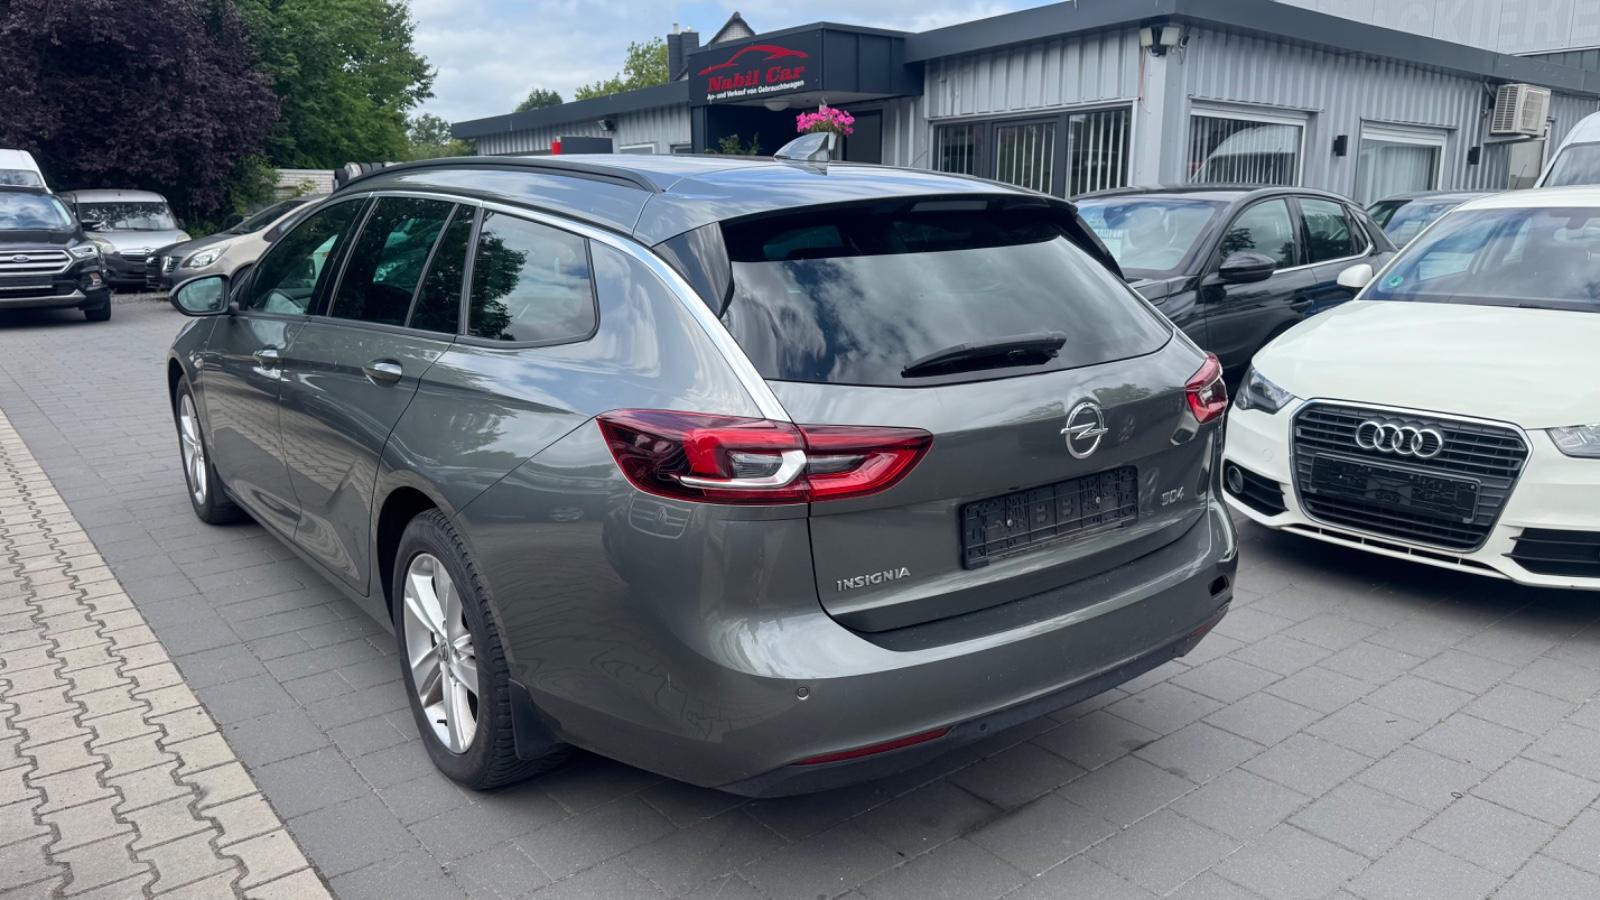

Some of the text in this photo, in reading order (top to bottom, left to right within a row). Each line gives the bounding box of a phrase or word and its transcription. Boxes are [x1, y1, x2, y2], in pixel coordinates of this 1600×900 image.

[766, 66, 805, 83] Car
[727, 88, 746, 97] Verkauf
[758, 80, 805, 94] Gebrauchtwagen
[837, 567, 911, 592] INSIGNIA
